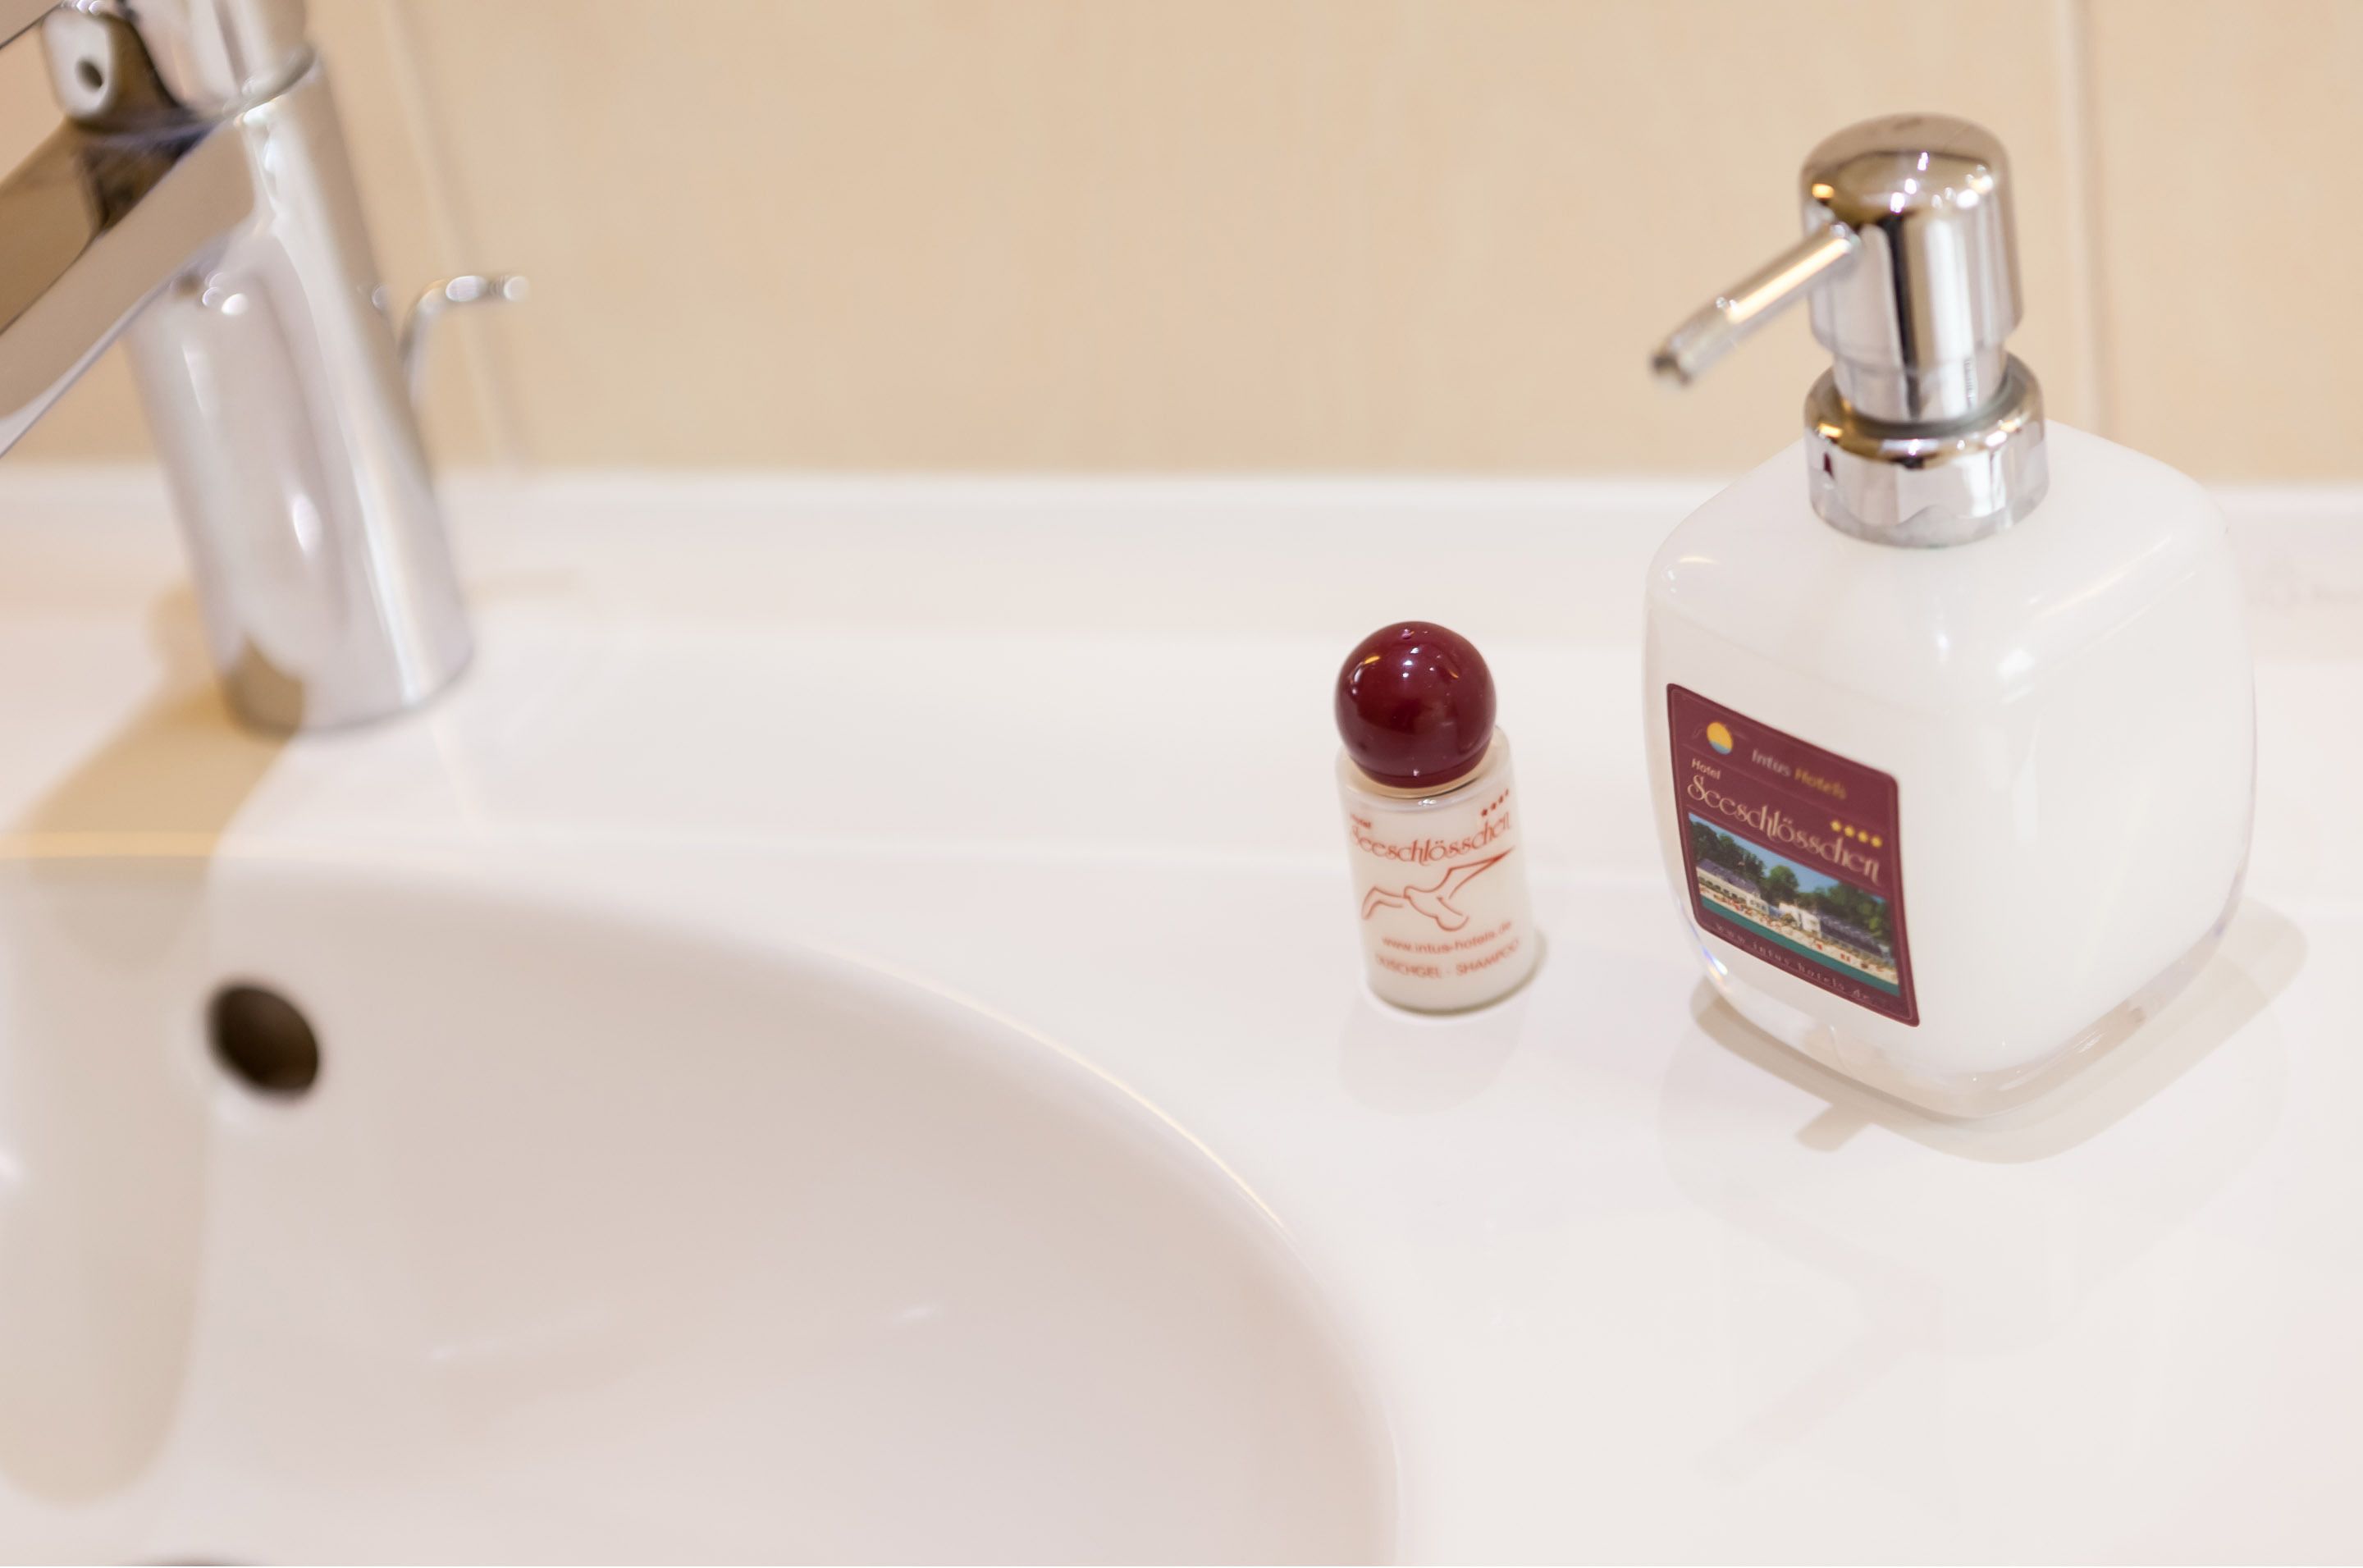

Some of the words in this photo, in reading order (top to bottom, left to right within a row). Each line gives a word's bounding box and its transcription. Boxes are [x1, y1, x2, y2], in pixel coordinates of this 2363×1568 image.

[1691, 757, 1721, 780] Hotel
[1751, 748, 1792, 778] Intus
[1794, 767, 1848, 801] Hotels
[1687, 774, 1881, 887] Seeschlösschen
